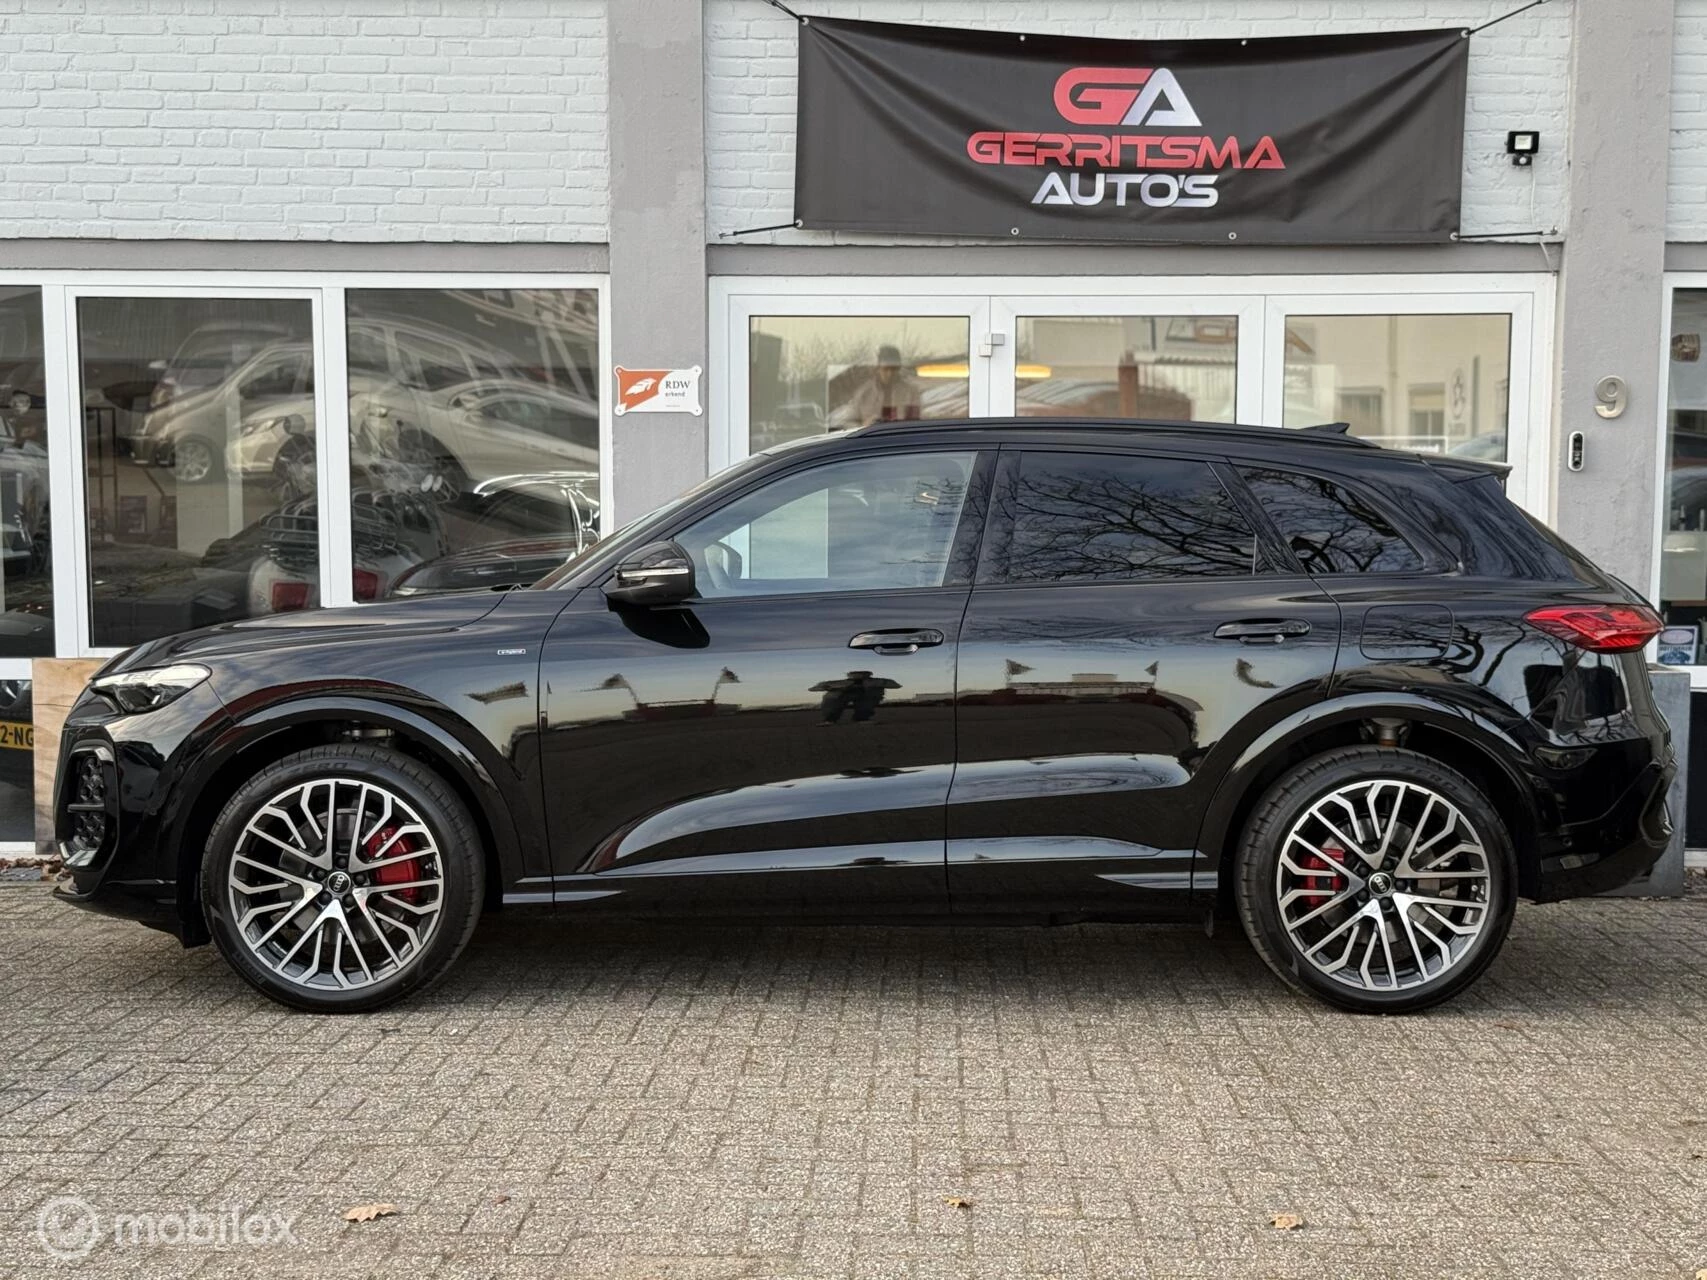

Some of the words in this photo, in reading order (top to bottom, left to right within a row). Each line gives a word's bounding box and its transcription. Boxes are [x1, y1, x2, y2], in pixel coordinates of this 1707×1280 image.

[1054, 67, 1202, 126] GA
[967, 131, 1285, 169] GERRITSMA
[1031, 172, 1219, 208] AUTO'S
[665, 380, 690, 389] RDW
[1595, 375, 1627, 418] 9
